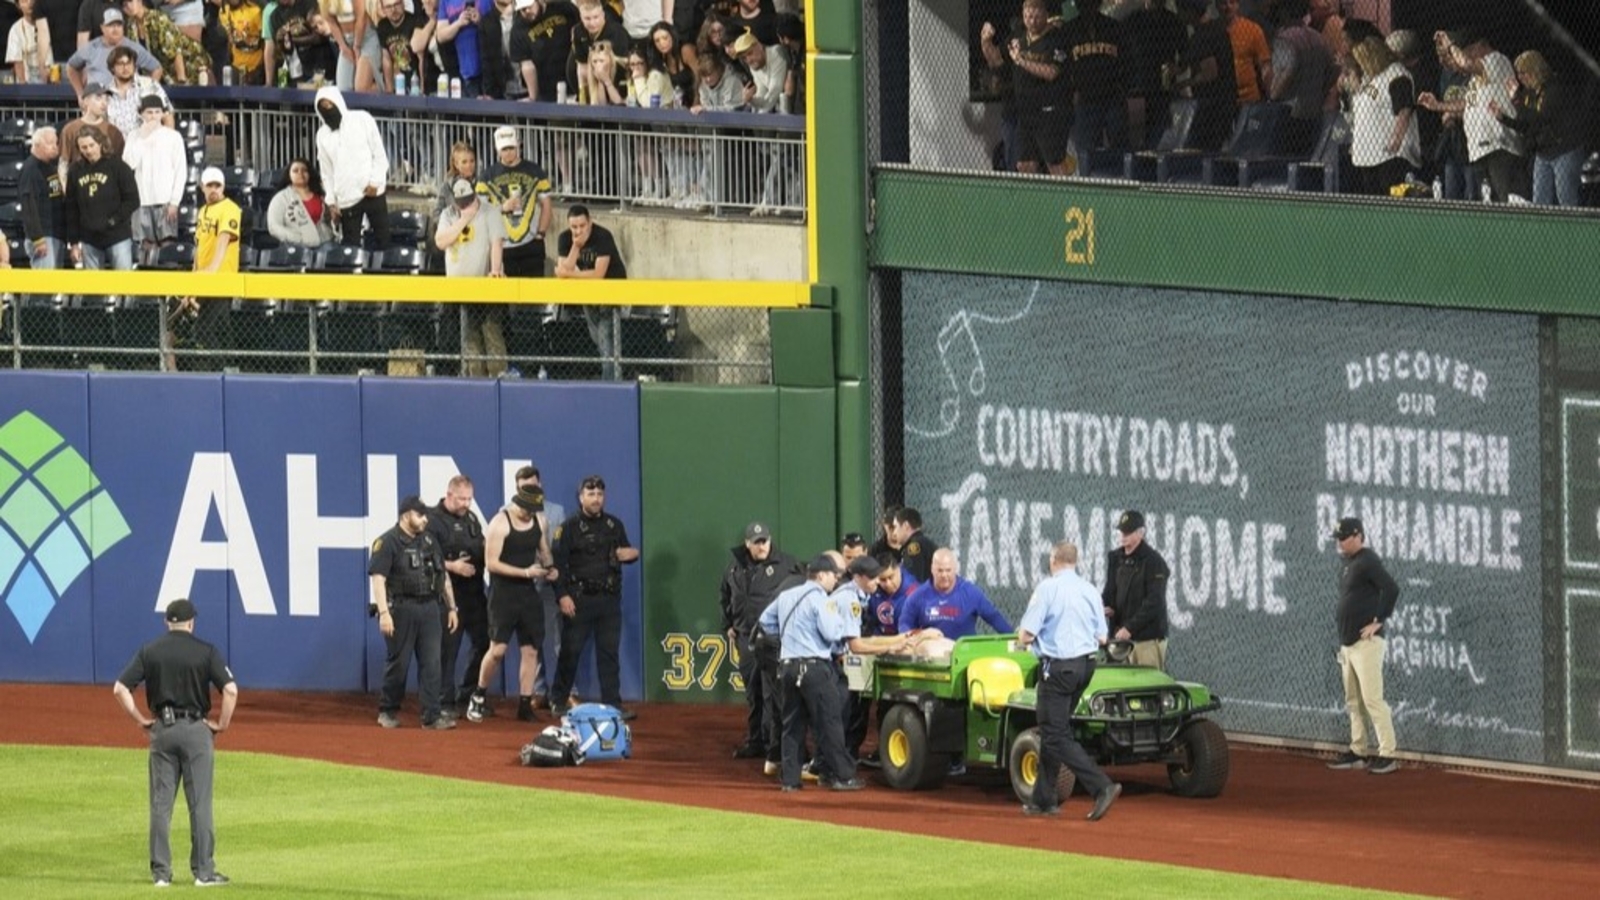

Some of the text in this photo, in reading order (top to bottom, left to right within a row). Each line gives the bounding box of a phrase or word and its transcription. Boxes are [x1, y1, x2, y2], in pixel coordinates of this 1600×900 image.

[1065, 206, 1095, 265] 21
[1346, 351, 1489, 403] DISCOVER
[1397, 392, 1436, 416] OUR
[978, 404, 1249, 500] COUNTRY ROADS,
[1325, 422, 1510, 496] NORTHERN
[941, 472, 1053, 590] TAKE
[1385, 604, 1453, 635] WEST
[1384, 635, 1487, 685] IRGINIA
